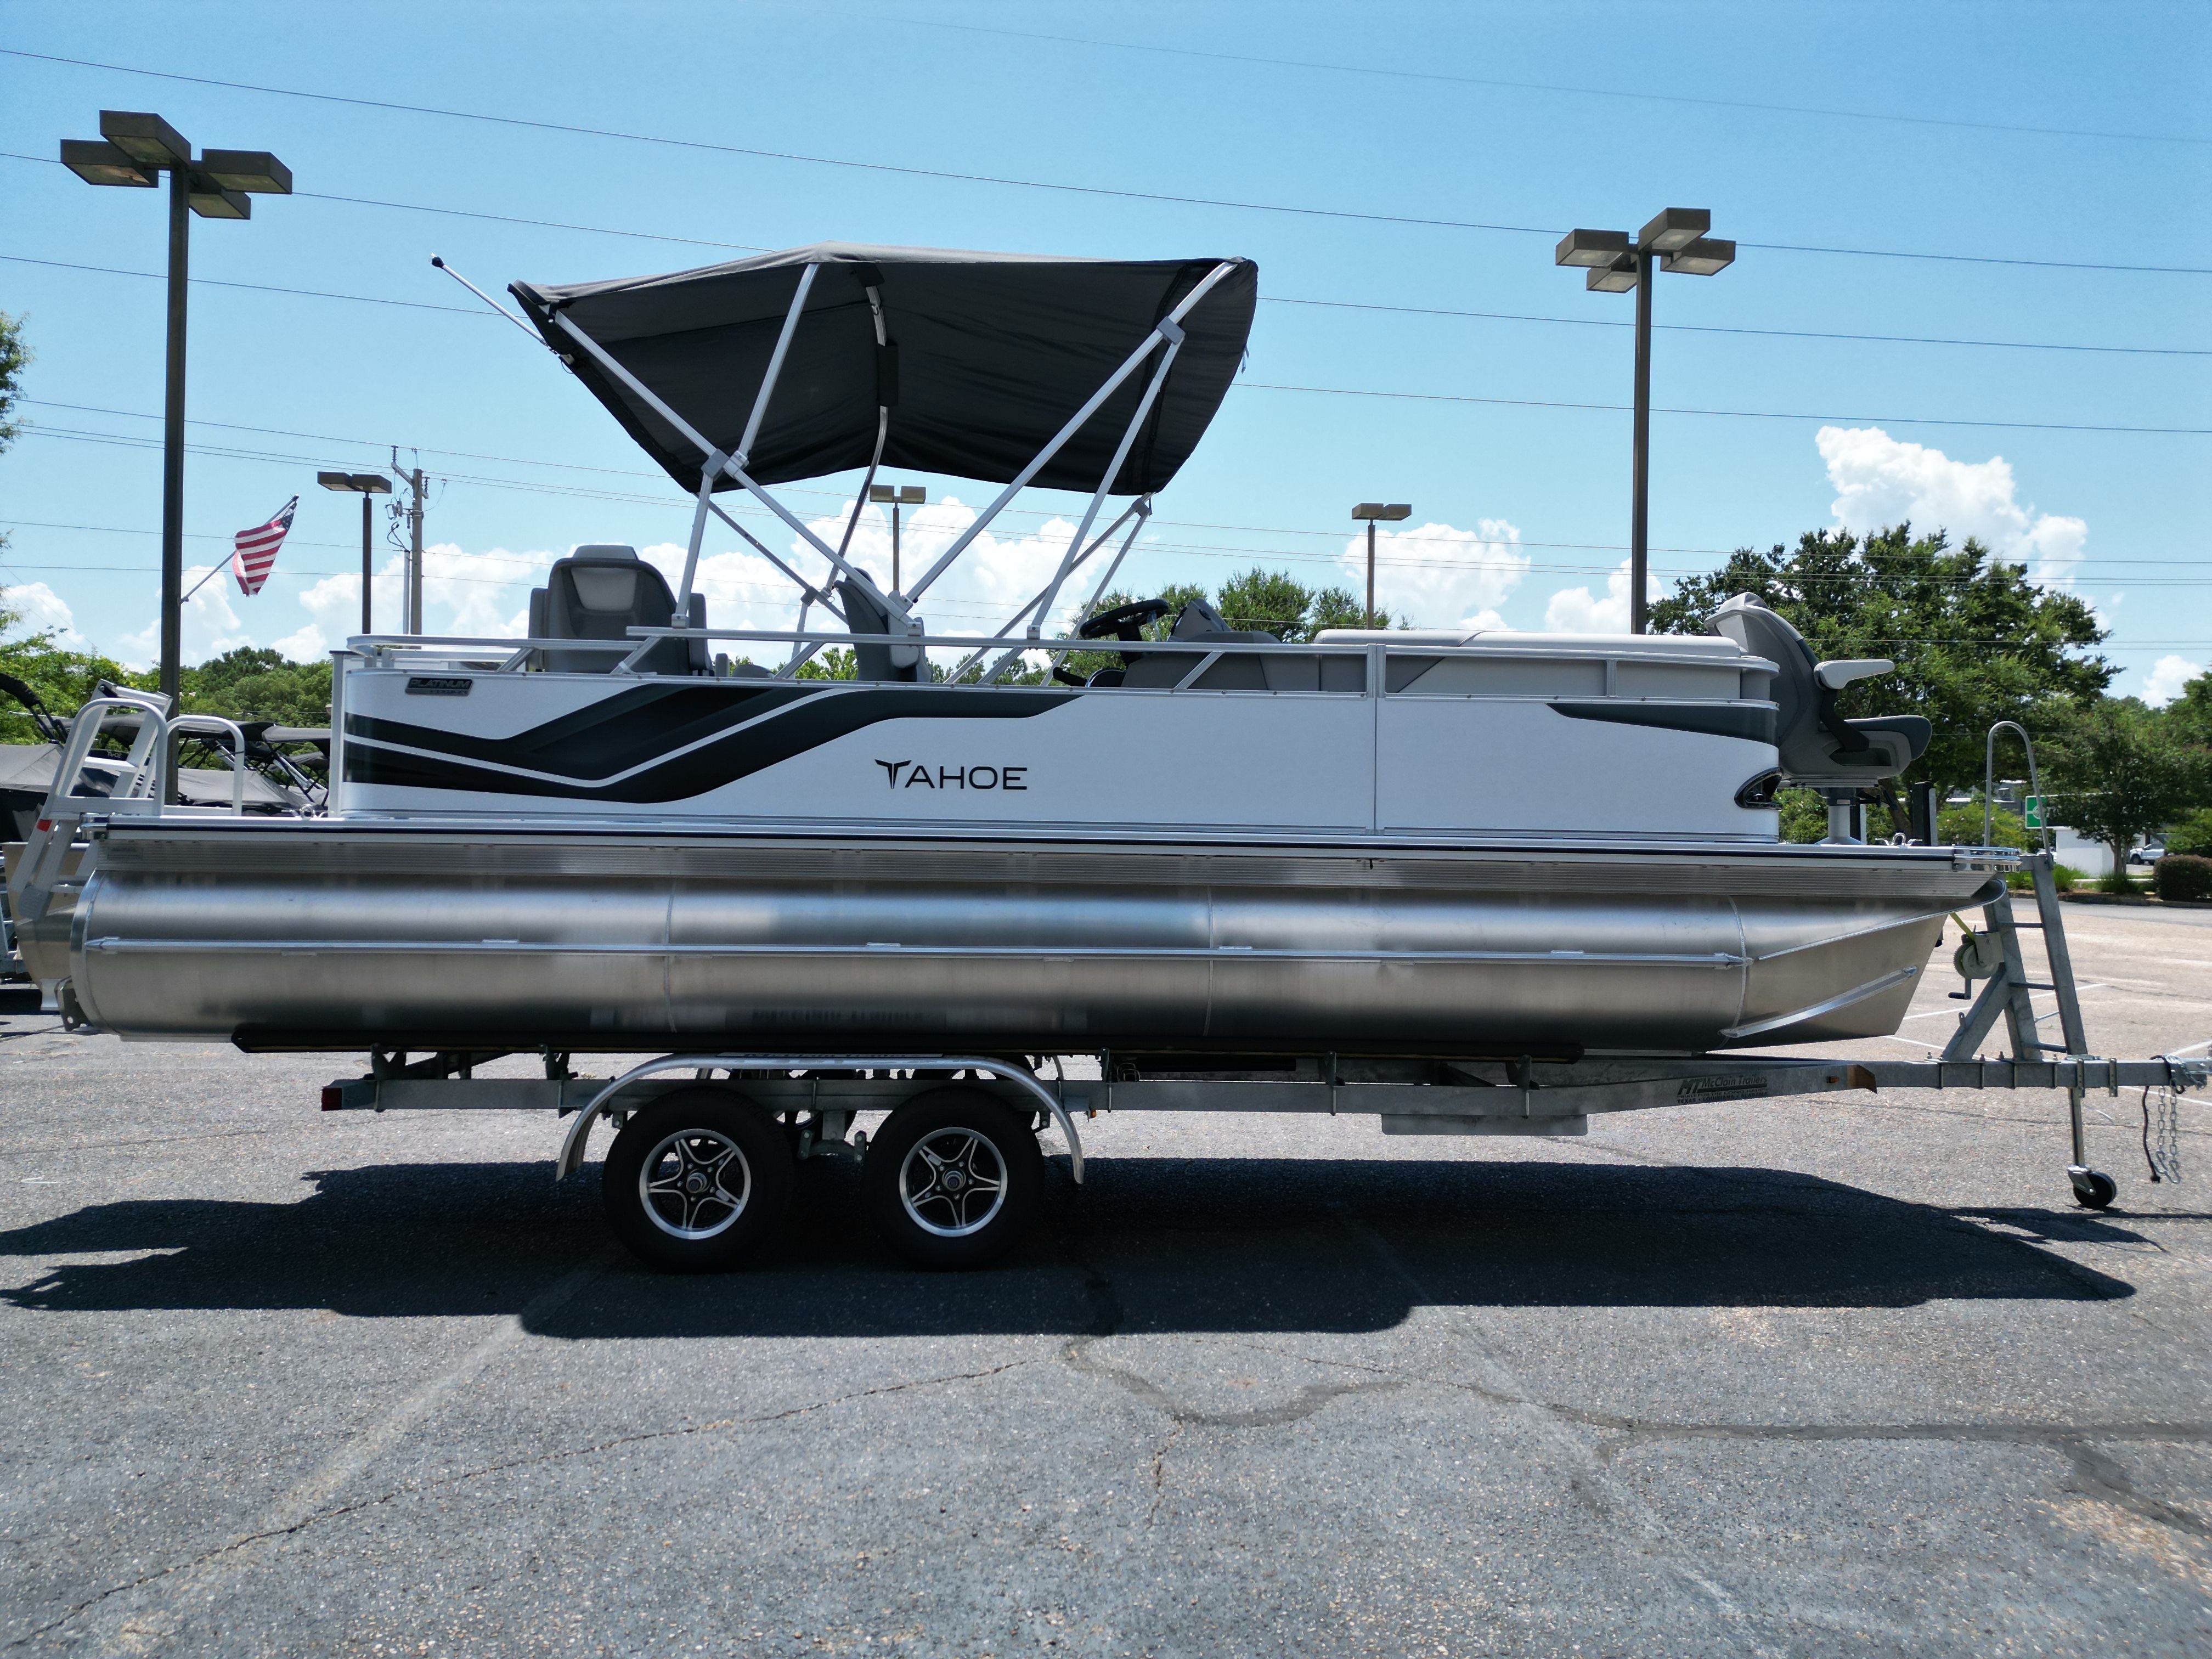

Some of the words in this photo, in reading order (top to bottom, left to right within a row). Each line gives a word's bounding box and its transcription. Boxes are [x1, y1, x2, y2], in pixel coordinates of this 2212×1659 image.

[411, 679, 470, 688] PLATINUM
[874, 759, 1028, 790] TAHOE
[1678, 1079, 1703, 1095] MT
[1702, 1076, 1736, 1088] McClain
[1739, 1074, 1767, 1085] Trailers
